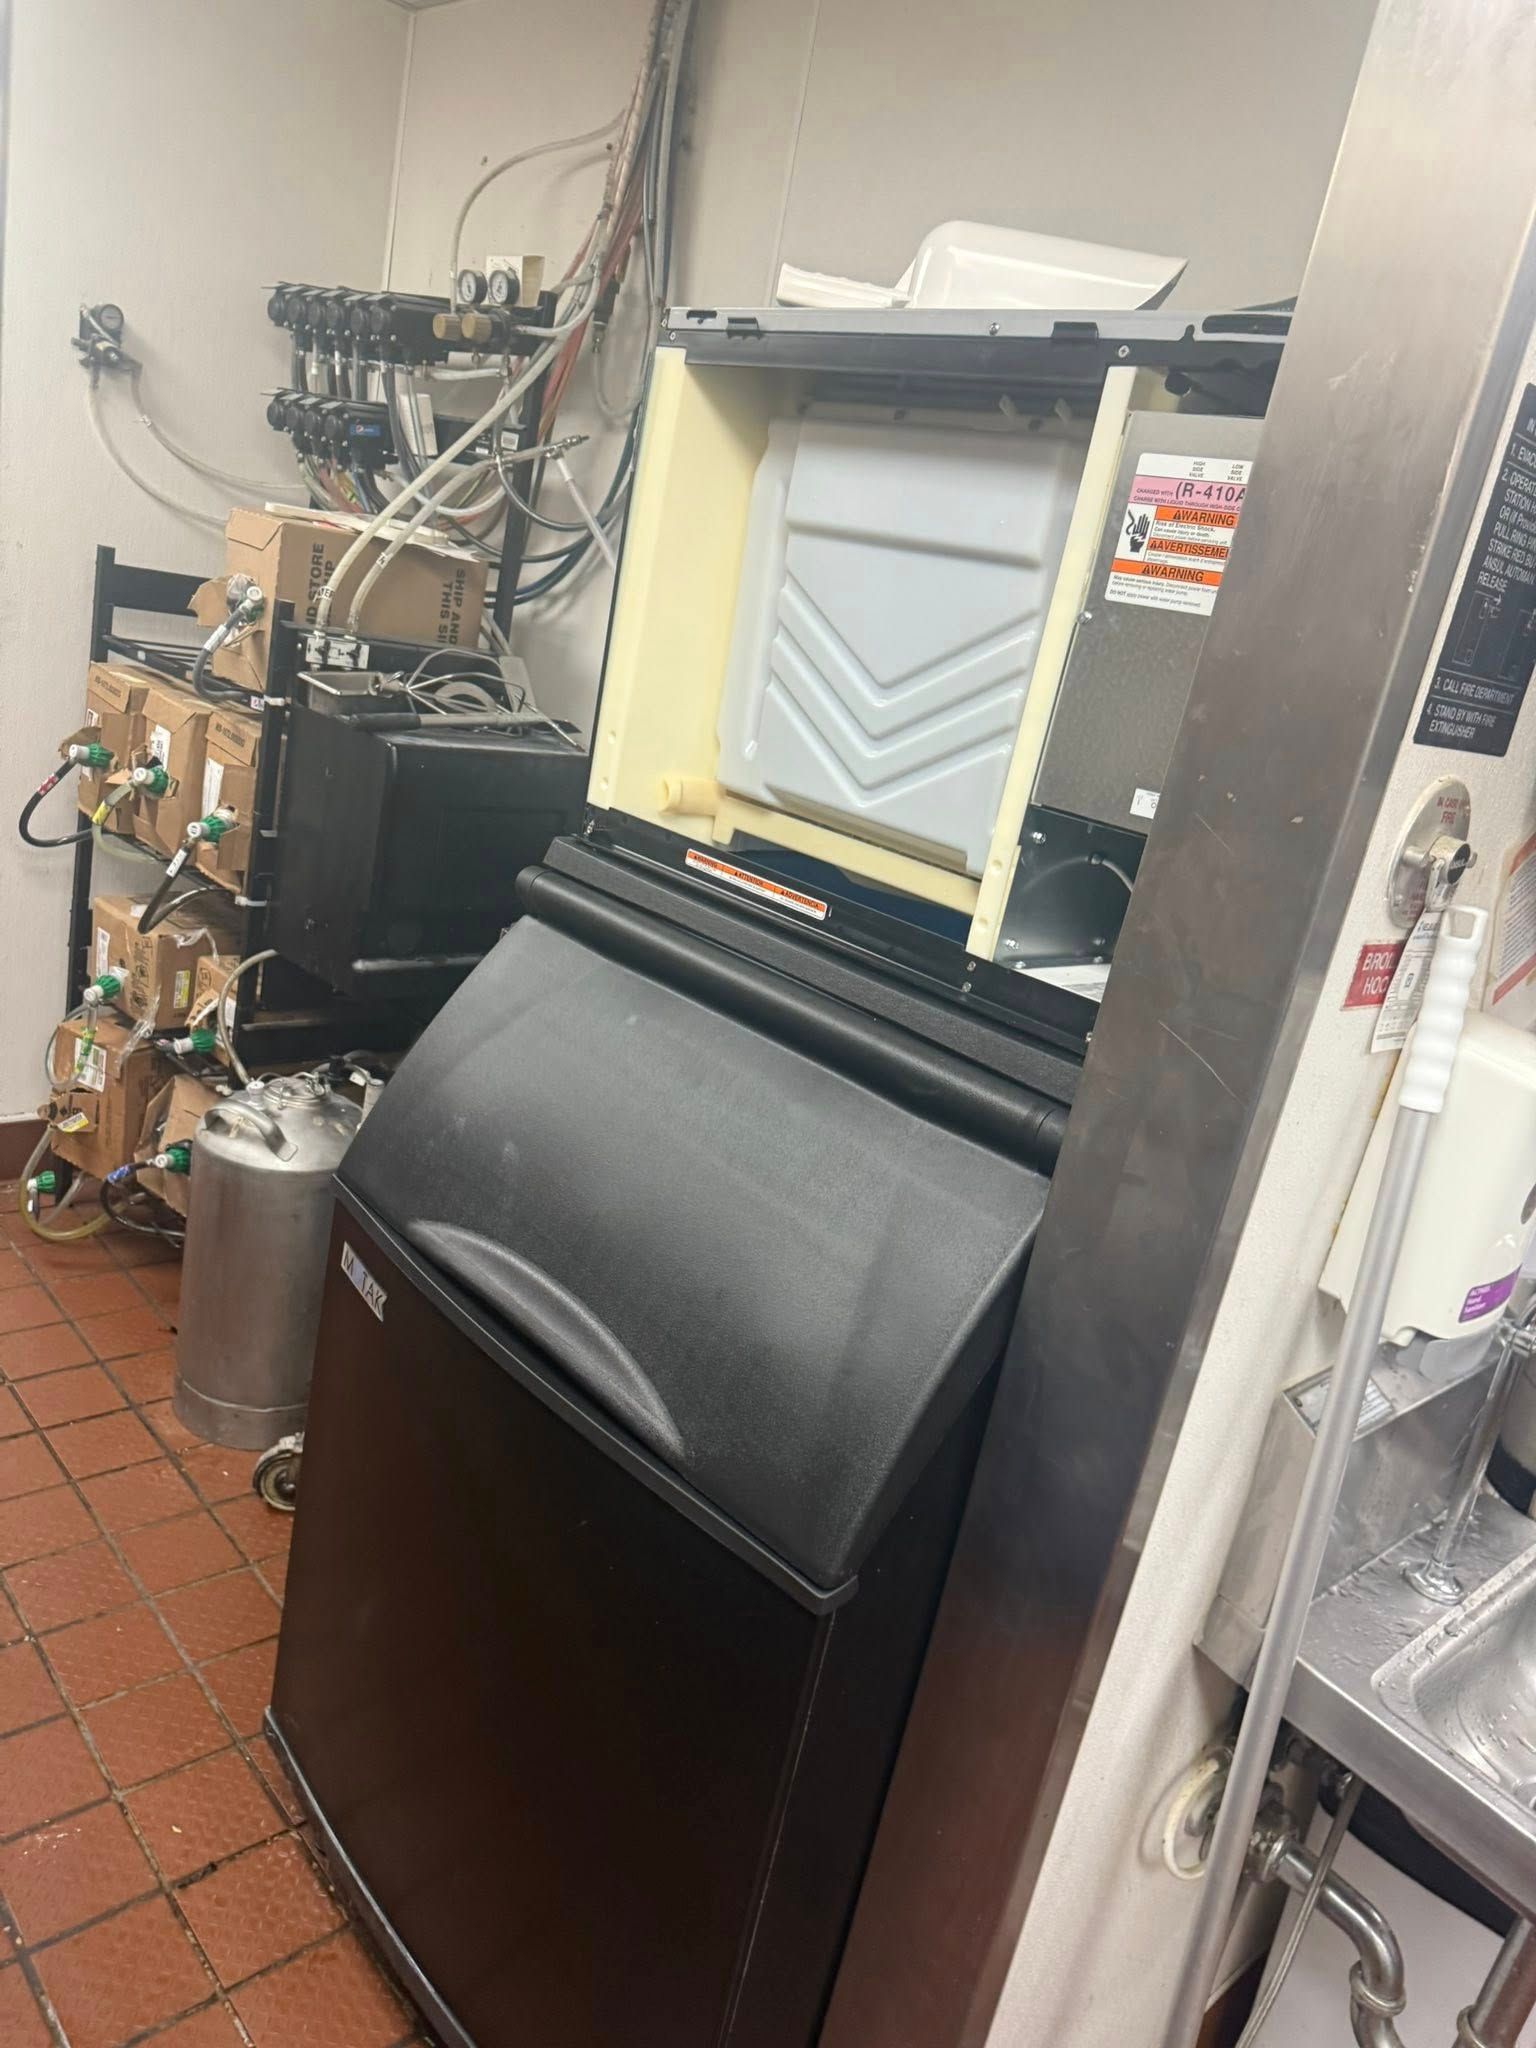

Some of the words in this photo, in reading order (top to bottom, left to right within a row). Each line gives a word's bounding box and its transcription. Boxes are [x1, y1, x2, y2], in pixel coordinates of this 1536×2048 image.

[1136, 487, 1159, 495] CHARGED
[1504, 488, 1531, 511] STATION
[1184, 501, 1209, 509] THROUGH
[1182, 510, 1235, 526] WARNING
[308, 543, 324, 601] STORE
[1150, 565, 1204, 582] WARNING
[1477, 571, 1508, 593] RELEASE
[453, 568, 465, 608] SHIP
[440, 582, 453, 619] THIS
[449, 611, 461, 645] AND
[1442, 679, 1459, 694] CALL
[1460, 682, 1476, 697] FIRE
[1474, 686, 1515, 705] DEPARTMENT
[1434, 704, 1457, 721] STAND
[1456, 709, 1467, 721] BY
[1466, 711, 1482, 724] WITH
[1481, 714, 1497, 728] FIRE
[1429, 720, 1476, 739] EXTINGUISHER
